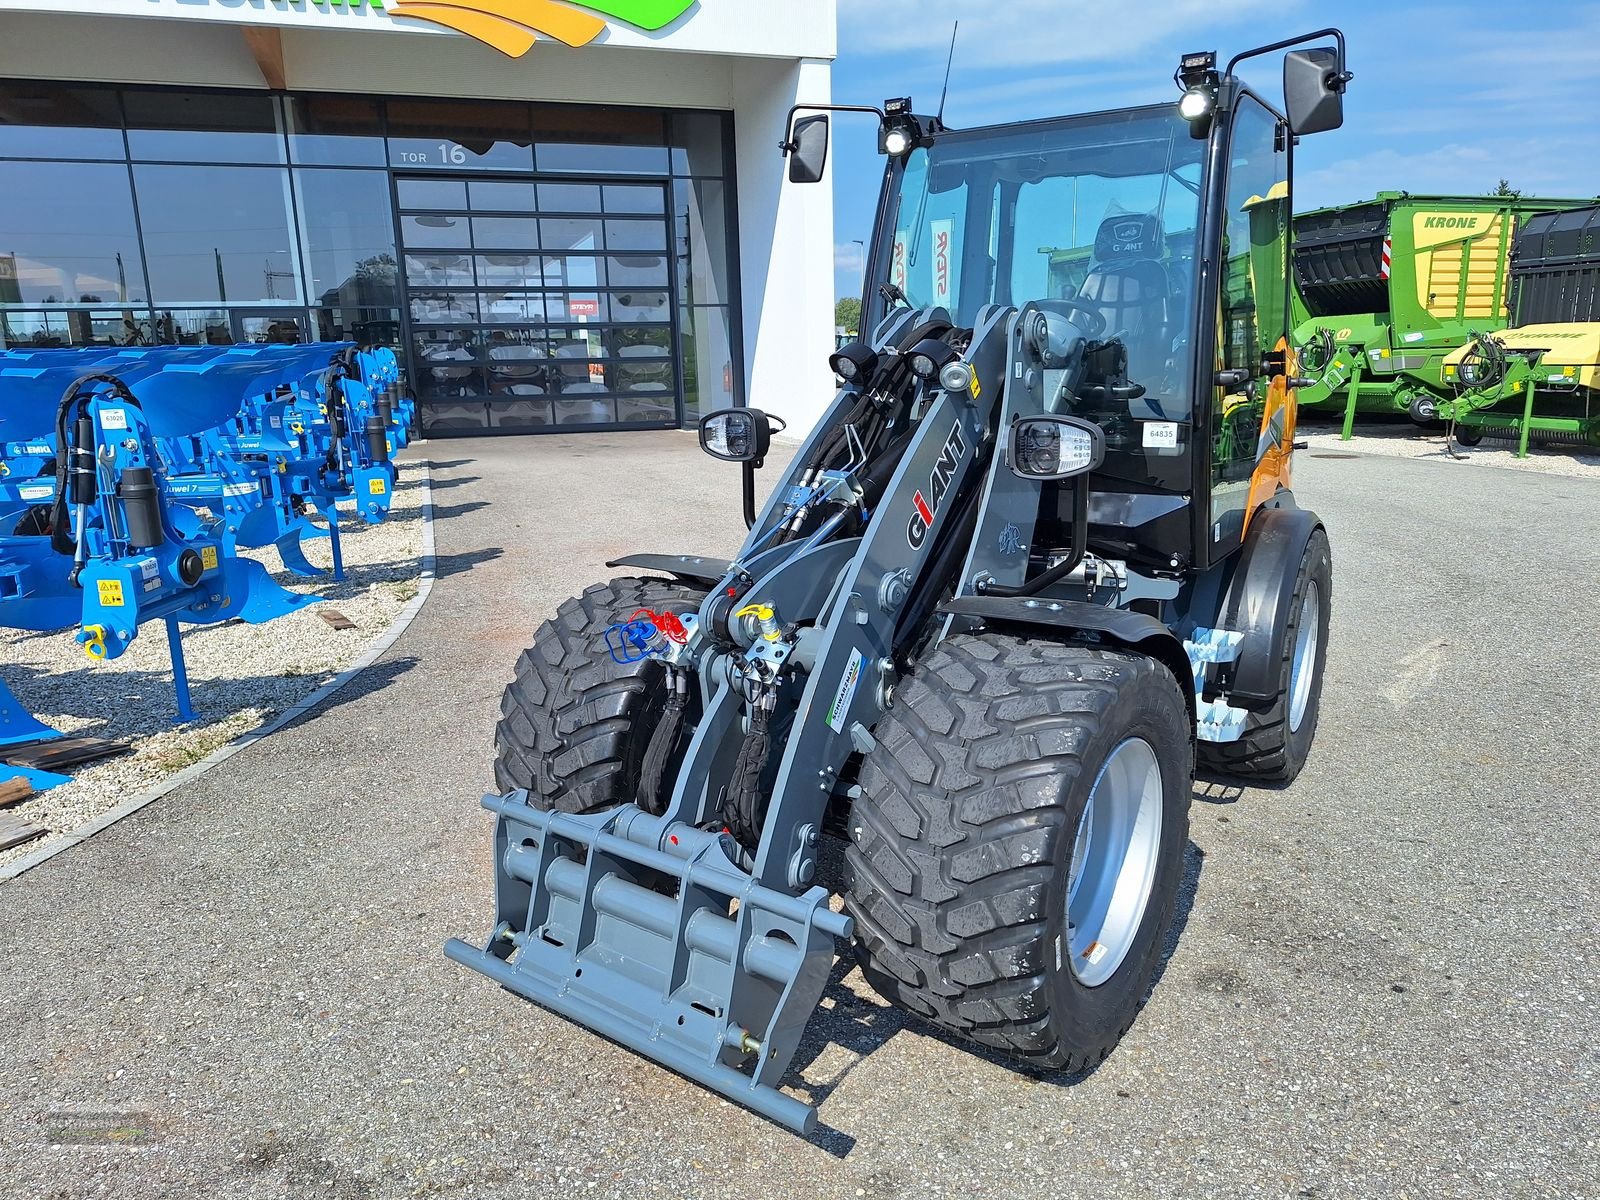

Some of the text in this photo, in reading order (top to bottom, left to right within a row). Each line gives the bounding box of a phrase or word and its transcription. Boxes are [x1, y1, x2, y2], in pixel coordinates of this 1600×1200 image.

[400, 144, 466, 164] TOR 16
[1424, 217, 1477, 229] KRONE
[1112, 242, 1144, 252] GANT
[1150, 430, 1173, 438] 64835
[164, 484, 198, 493] Juwel 7
[832, 661, 856, 720] SCHWARZMAYR
